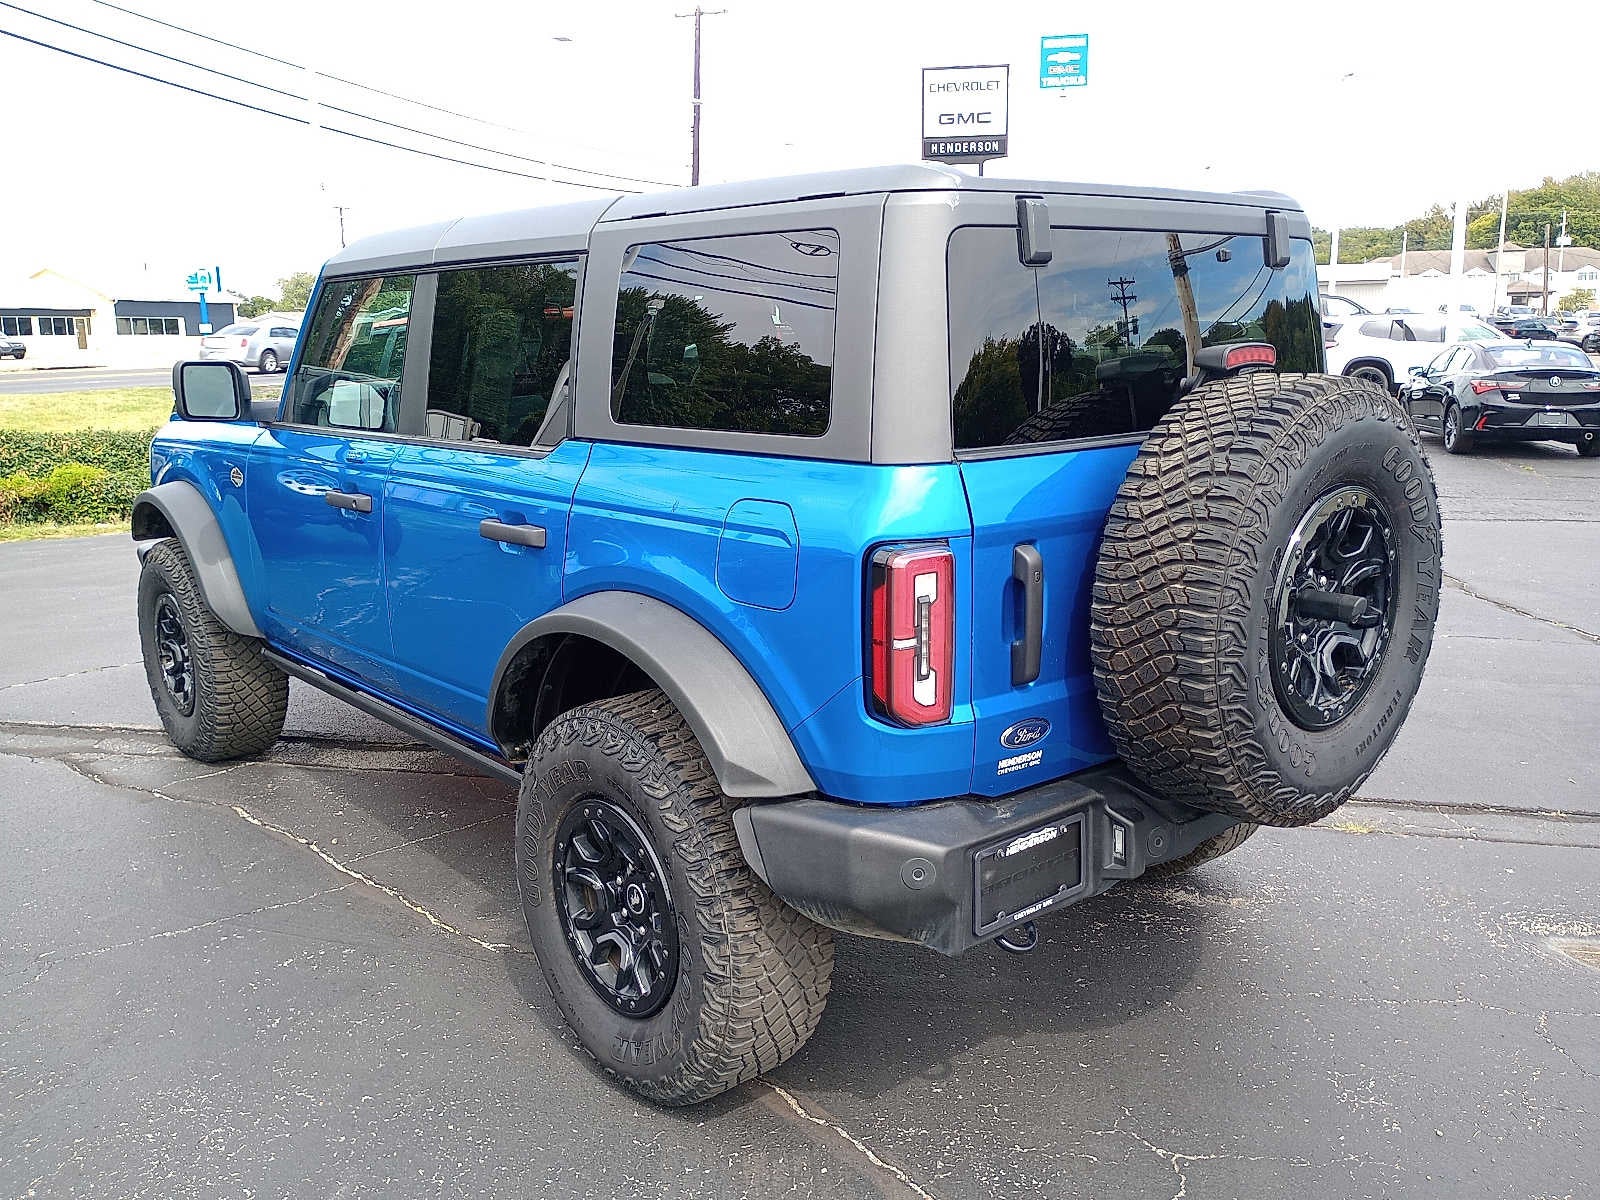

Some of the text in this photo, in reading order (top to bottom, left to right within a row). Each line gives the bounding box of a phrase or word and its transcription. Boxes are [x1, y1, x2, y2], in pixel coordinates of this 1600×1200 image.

[929, 80, 1000, 93] CHEVROLET
[938, 111, 991, 125] GMC
[930, 140, 999, 154] HENDERSON
[1014, 726, 1041, 744] Ford
[998, 750, 1042, 769] HENDERSON
[997, 762, 1028, 775] CHEVROLET
[1005, 829, 1058, 856] HENDERSON
